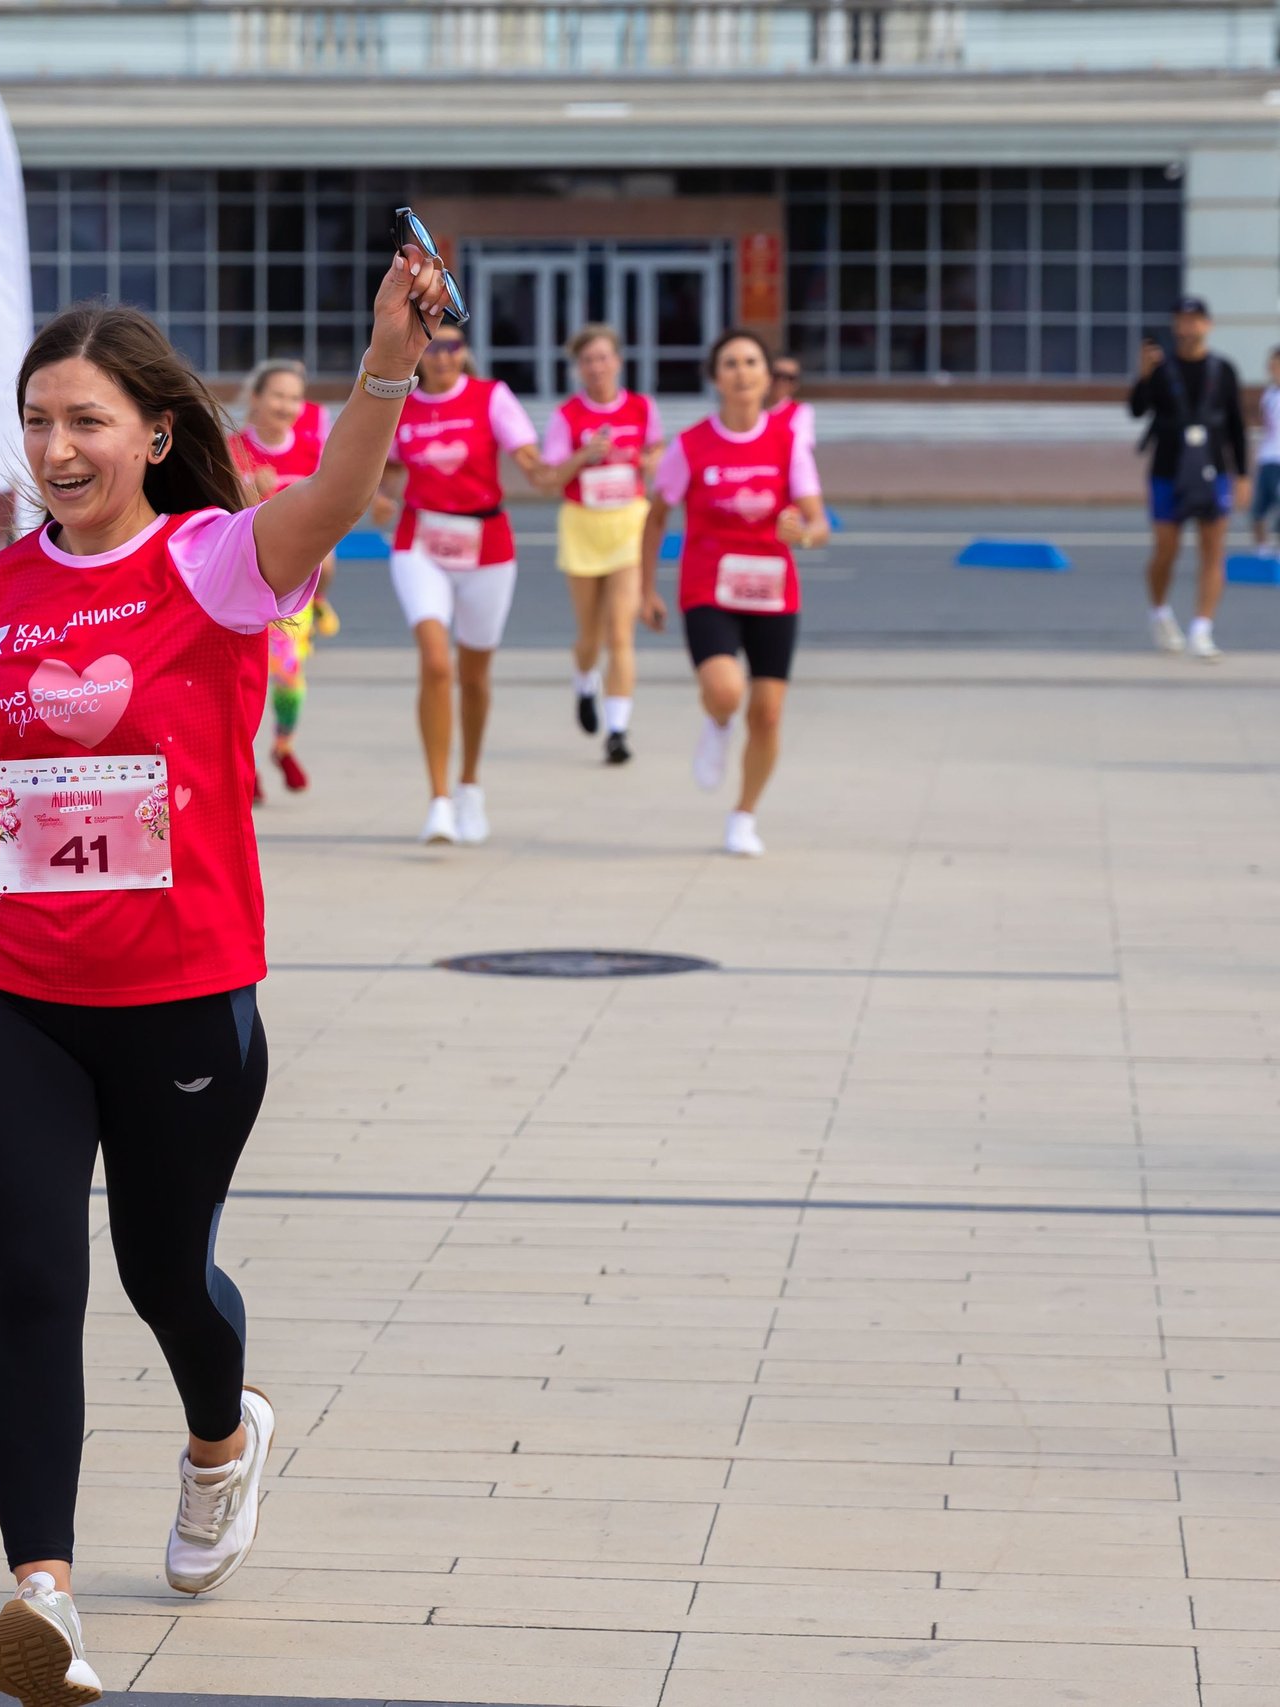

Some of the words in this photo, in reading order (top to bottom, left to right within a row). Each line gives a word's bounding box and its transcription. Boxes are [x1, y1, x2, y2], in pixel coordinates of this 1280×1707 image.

[31, 678, 129, 703] беговых
[8, 698, 102, 738] принцесс
[51, 789, 103, 808] ЖЕНСКИЙ
[50, 835, 109, 874] 41
